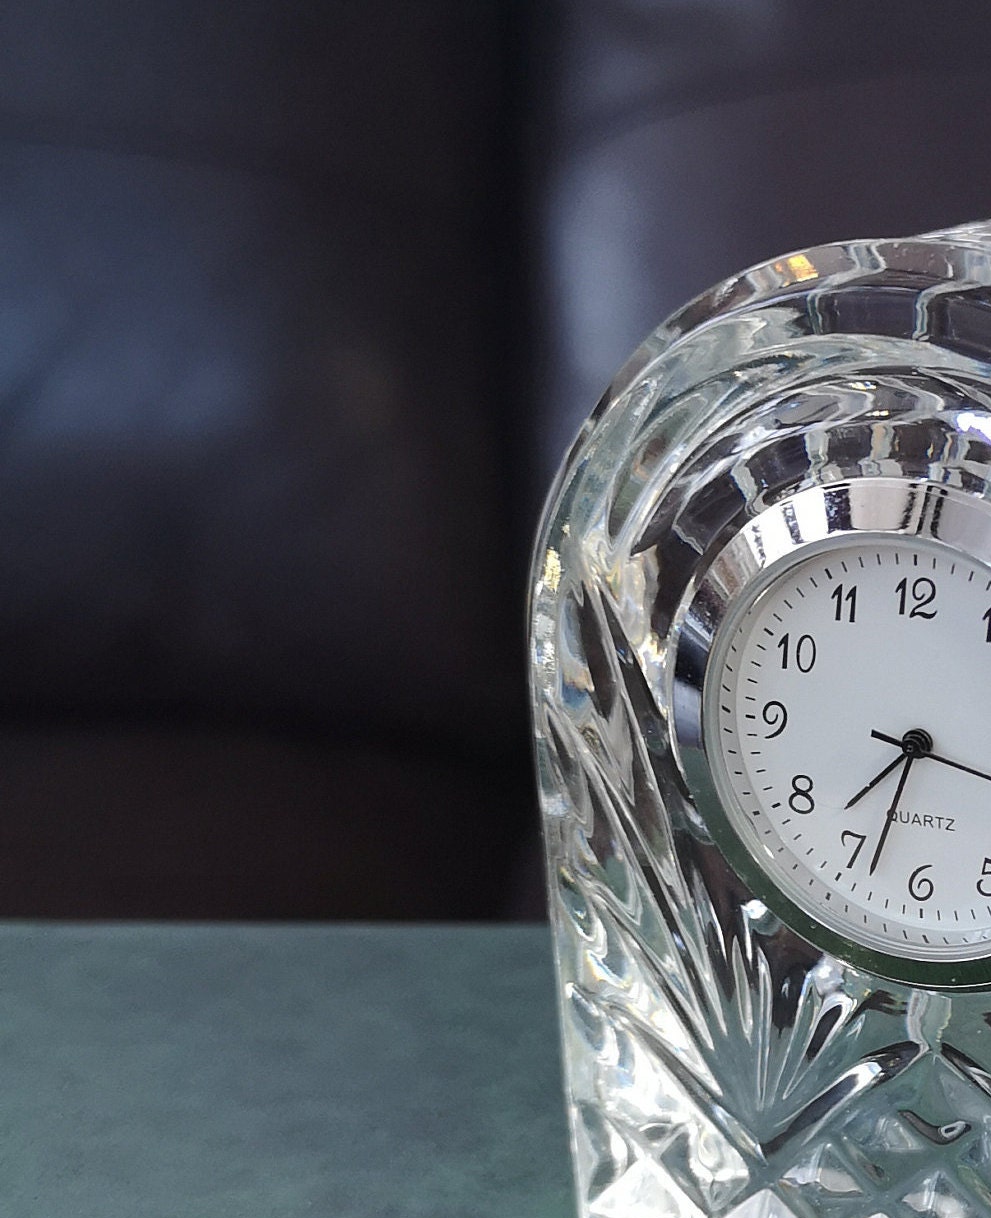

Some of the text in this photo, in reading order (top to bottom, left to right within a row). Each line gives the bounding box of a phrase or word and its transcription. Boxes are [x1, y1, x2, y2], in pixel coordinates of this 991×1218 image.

[831, 583, 857, 623] 11
[894, 577, 938, 620] 12
[778, 633, 817, 673] 10
[762, 701, 788, 739] 9
[789, 775, 815, 814] 8
[841, 831, 867, 869] 7
[908, 864, 934, 902] 6
